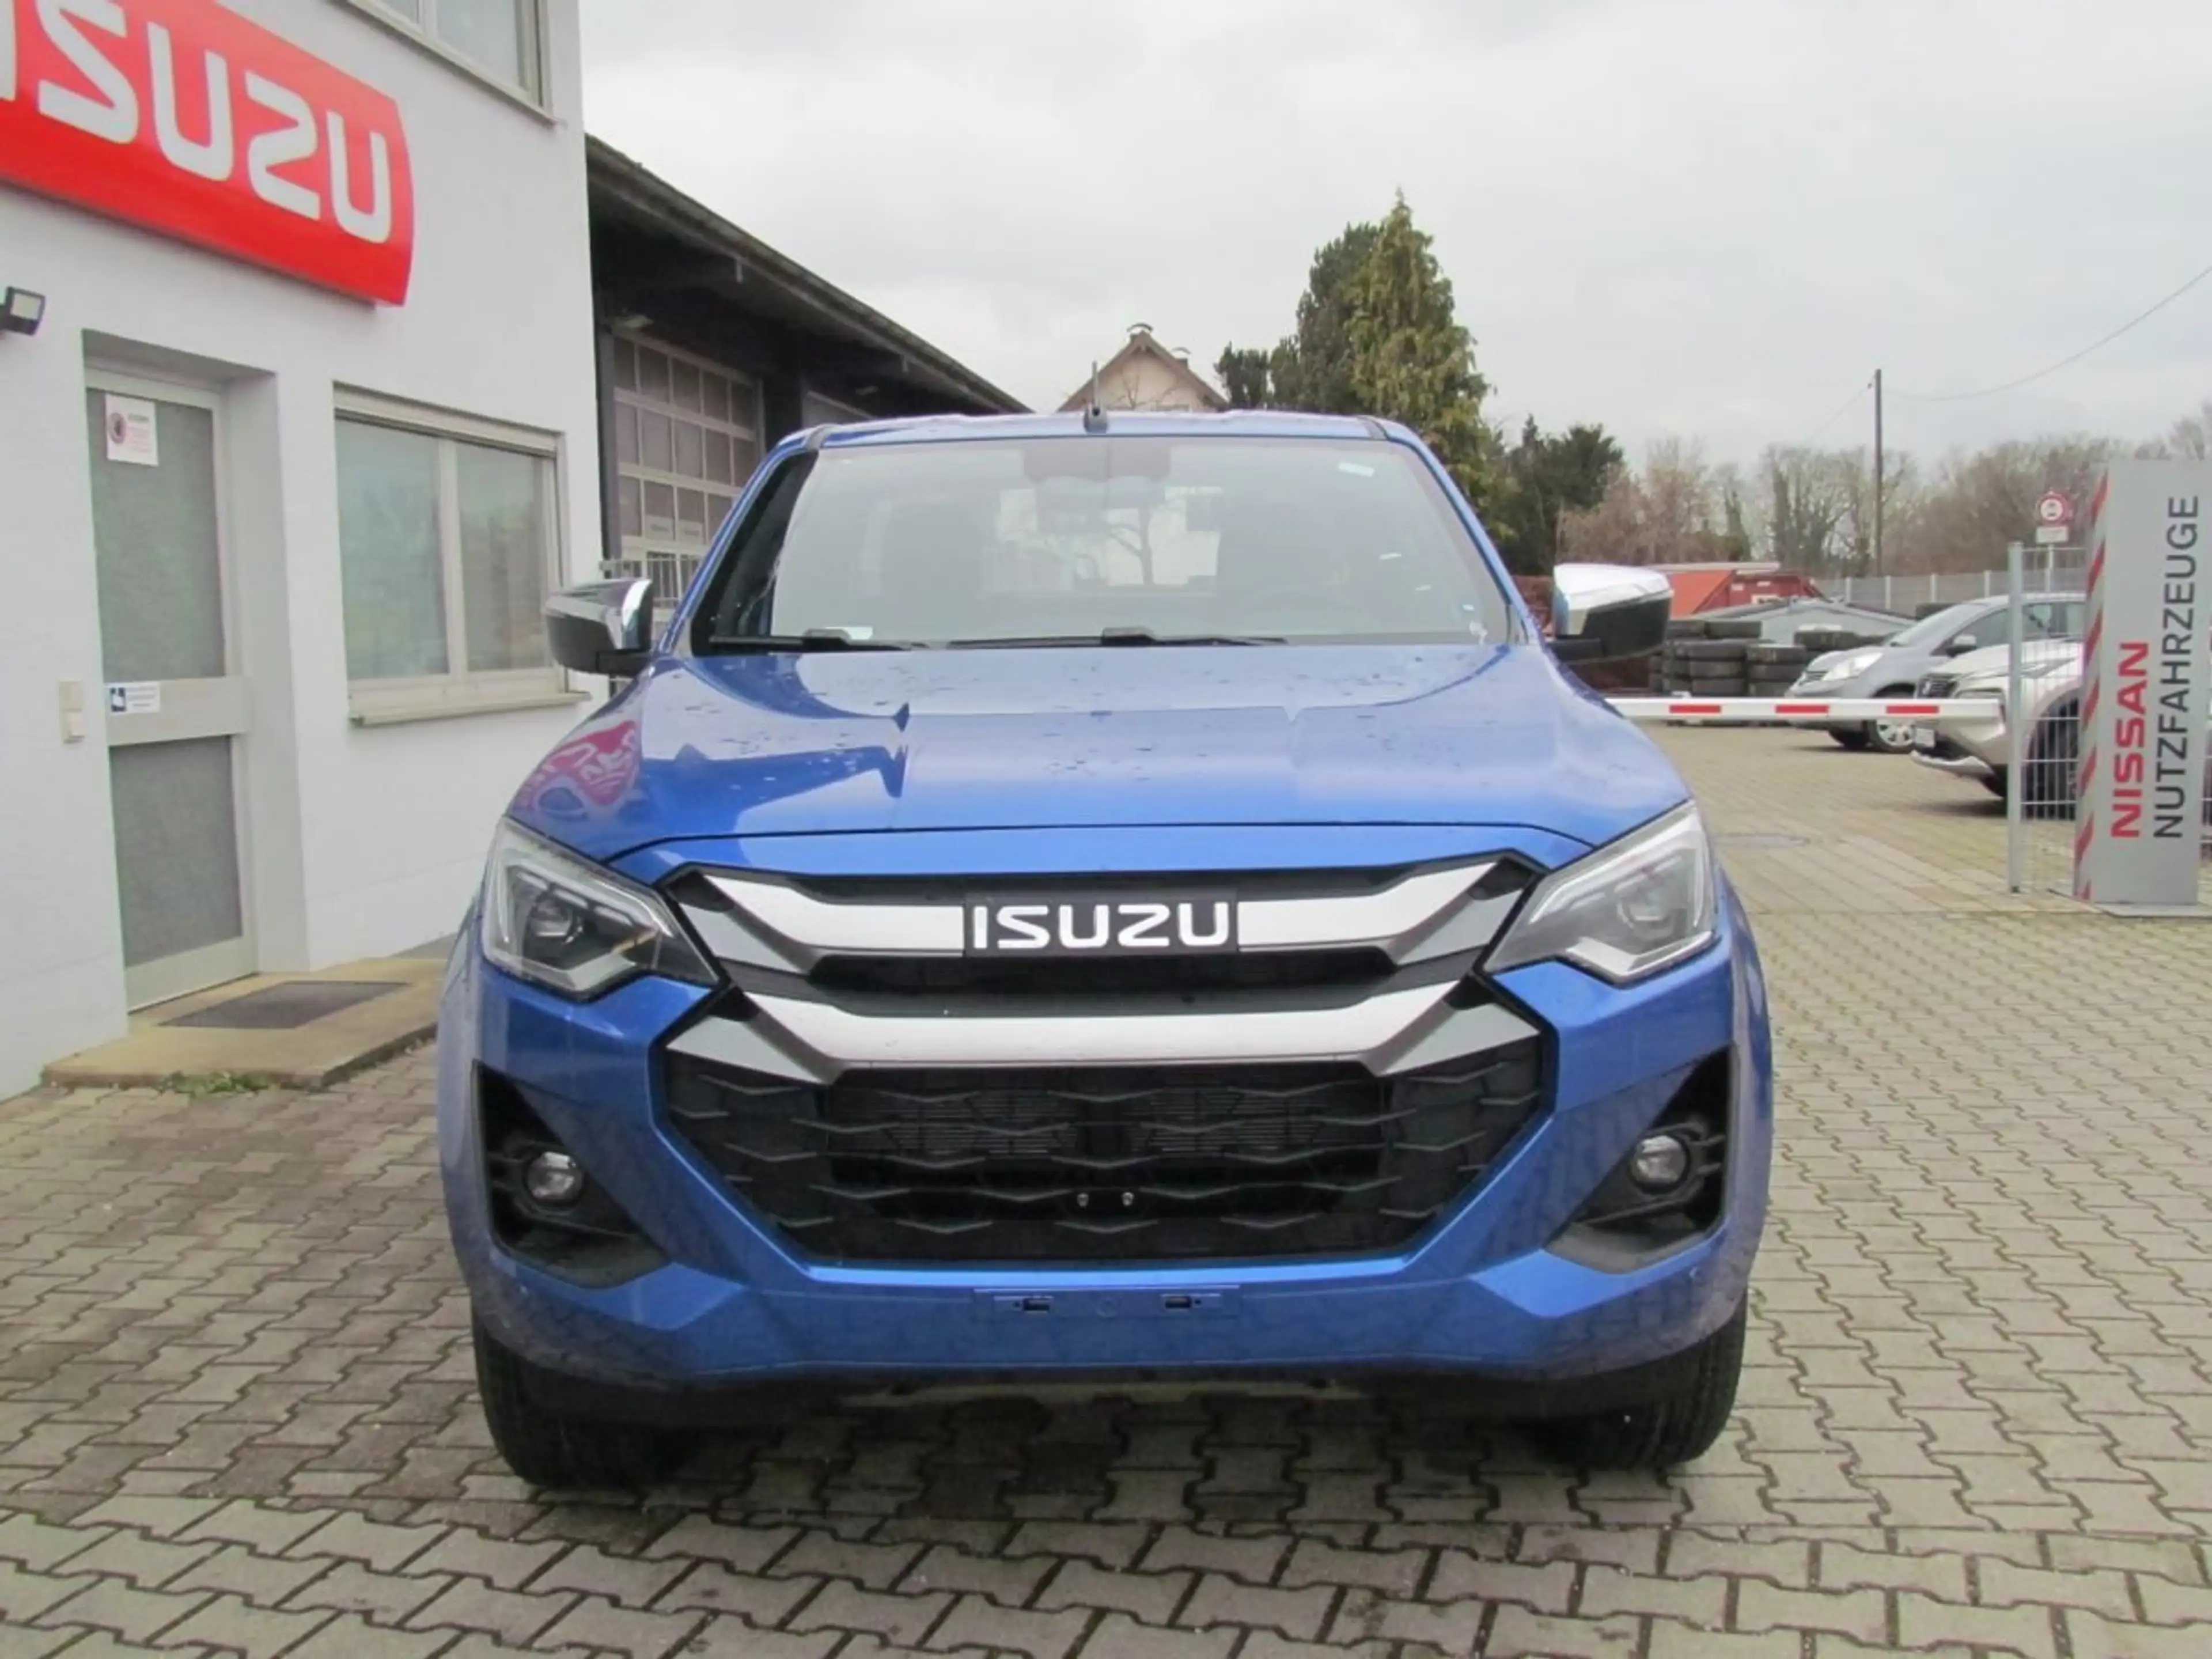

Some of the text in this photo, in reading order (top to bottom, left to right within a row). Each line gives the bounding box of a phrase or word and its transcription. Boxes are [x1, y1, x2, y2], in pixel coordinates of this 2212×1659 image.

[2111, 642, 2149, 838] NISSAN
[2152, 496, 2199, 839] NUTZFAHRZEUGE
[973, 902, 1229, 949] ISUZU
